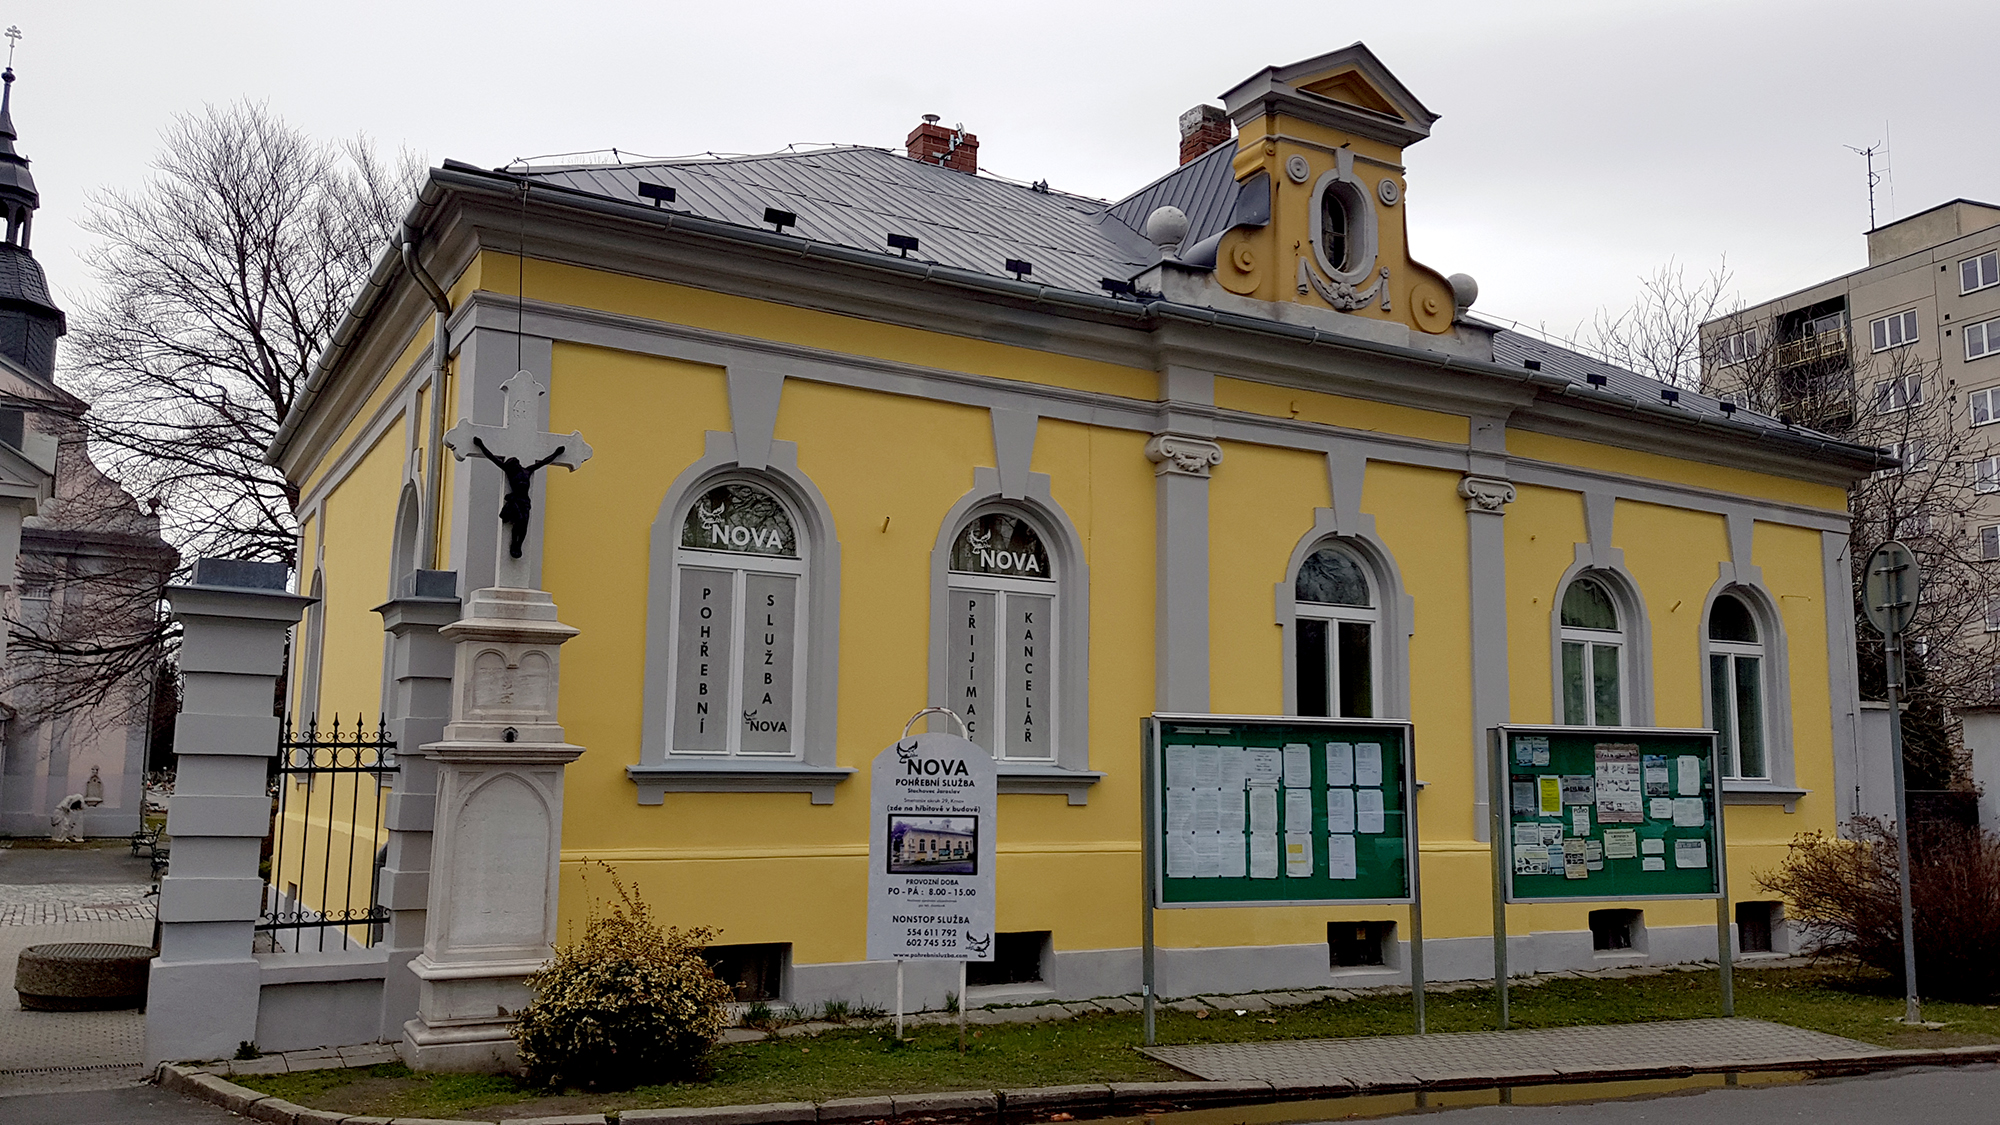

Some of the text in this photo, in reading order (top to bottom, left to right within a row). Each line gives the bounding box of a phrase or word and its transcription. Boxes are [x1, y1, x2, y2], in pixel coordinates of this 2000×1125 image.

[712, 524, 783, 549] NOVA
[981, 550, 1039, 572] NOVA
[762, 594, 775, 705] SLUŽBA
[697, 588, 712, 734] POHŘEBNÍ
[1024, 612, 1034, 743] KANCELÁŘ
[749, 720, 788, 733] NOVA
[907, 759, 969, 776] NOVA
[895, 777, 976, 787] POHŘEBNÍ SLUŽBA
[888, 887, 900, 895] PO
[907, 886, 919, 895] PÁ
[928, 888, 947, 896] 8.00
[954, 888, 976, 897] 15.00
[892, 914, 970, 924] NONSTOP SLUŽBA
[941, 929, 957, 937] 792
[906, 939, 957, 947] 602 745 525
